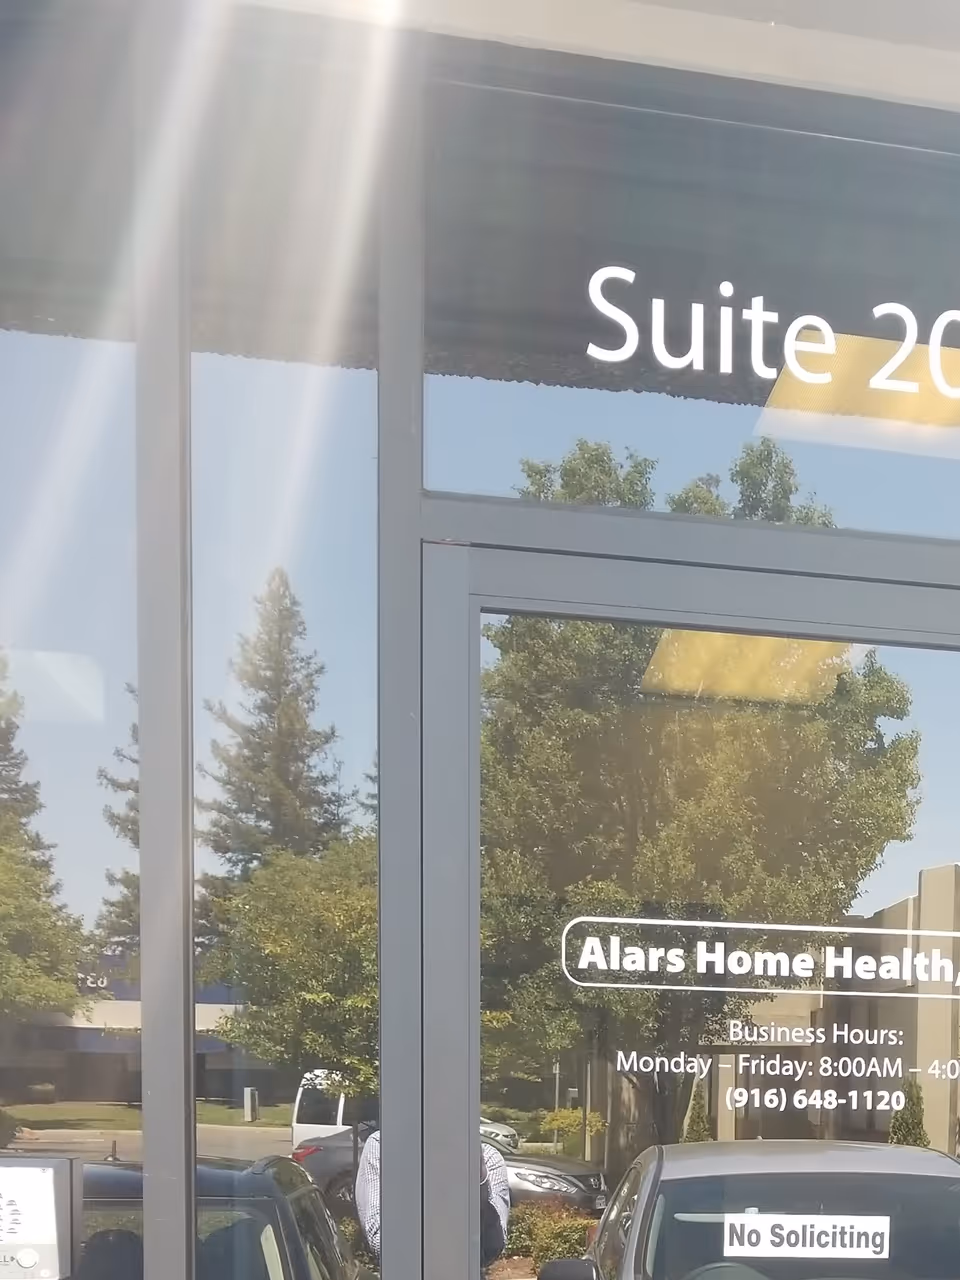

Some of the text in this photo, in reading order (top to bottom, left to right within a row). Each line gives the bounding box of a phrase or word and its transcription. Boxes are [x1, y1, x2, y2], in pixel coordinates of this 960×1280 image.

[585, 265, 837, 385] Suite
[578, 935, 686, 974] Alars
[696, 940, 815, 978] Home
[729, 1021, 904, 1046] Business Hours:
[616, 1050, 713, 1079] Monday
[739, 1055, 814, 1081] Friday:
[819, 1057, 904, 1079] 8:00AM
[725, 1086, 905, 1112] (916) 648-1120
[729, 1223, 886, 1255] No Soliciting
